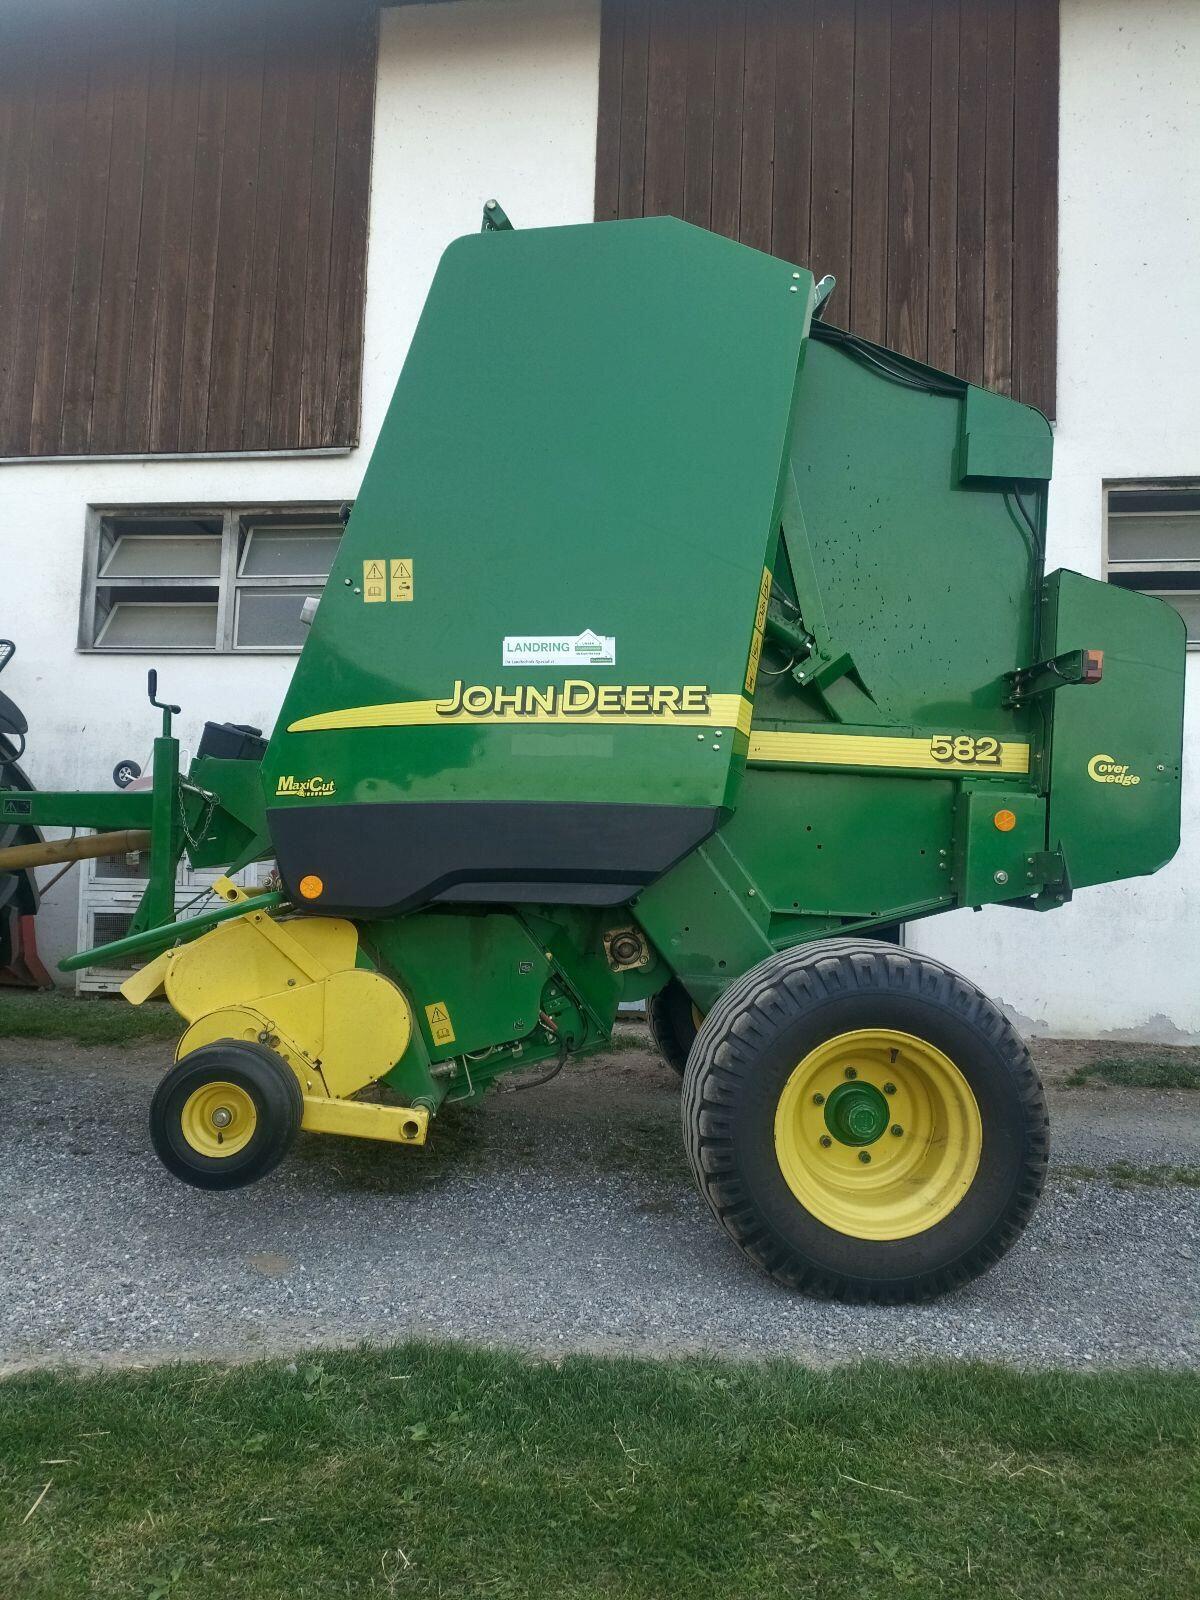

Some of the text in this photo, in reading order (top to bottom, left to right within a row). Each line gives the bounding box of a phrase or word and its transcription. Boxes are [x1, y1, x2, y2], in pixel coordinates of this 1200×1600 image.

[507, 643, 570, 652] LANDRING
[436, 679, 711, 716] JOHN DEERE
[930, 734, 1001, 765] 582
[1087, 754, 1129, 783] Cover
[277, 775, 335, 792] MaxiCut
[1105, 774, 1141, 787] edge
